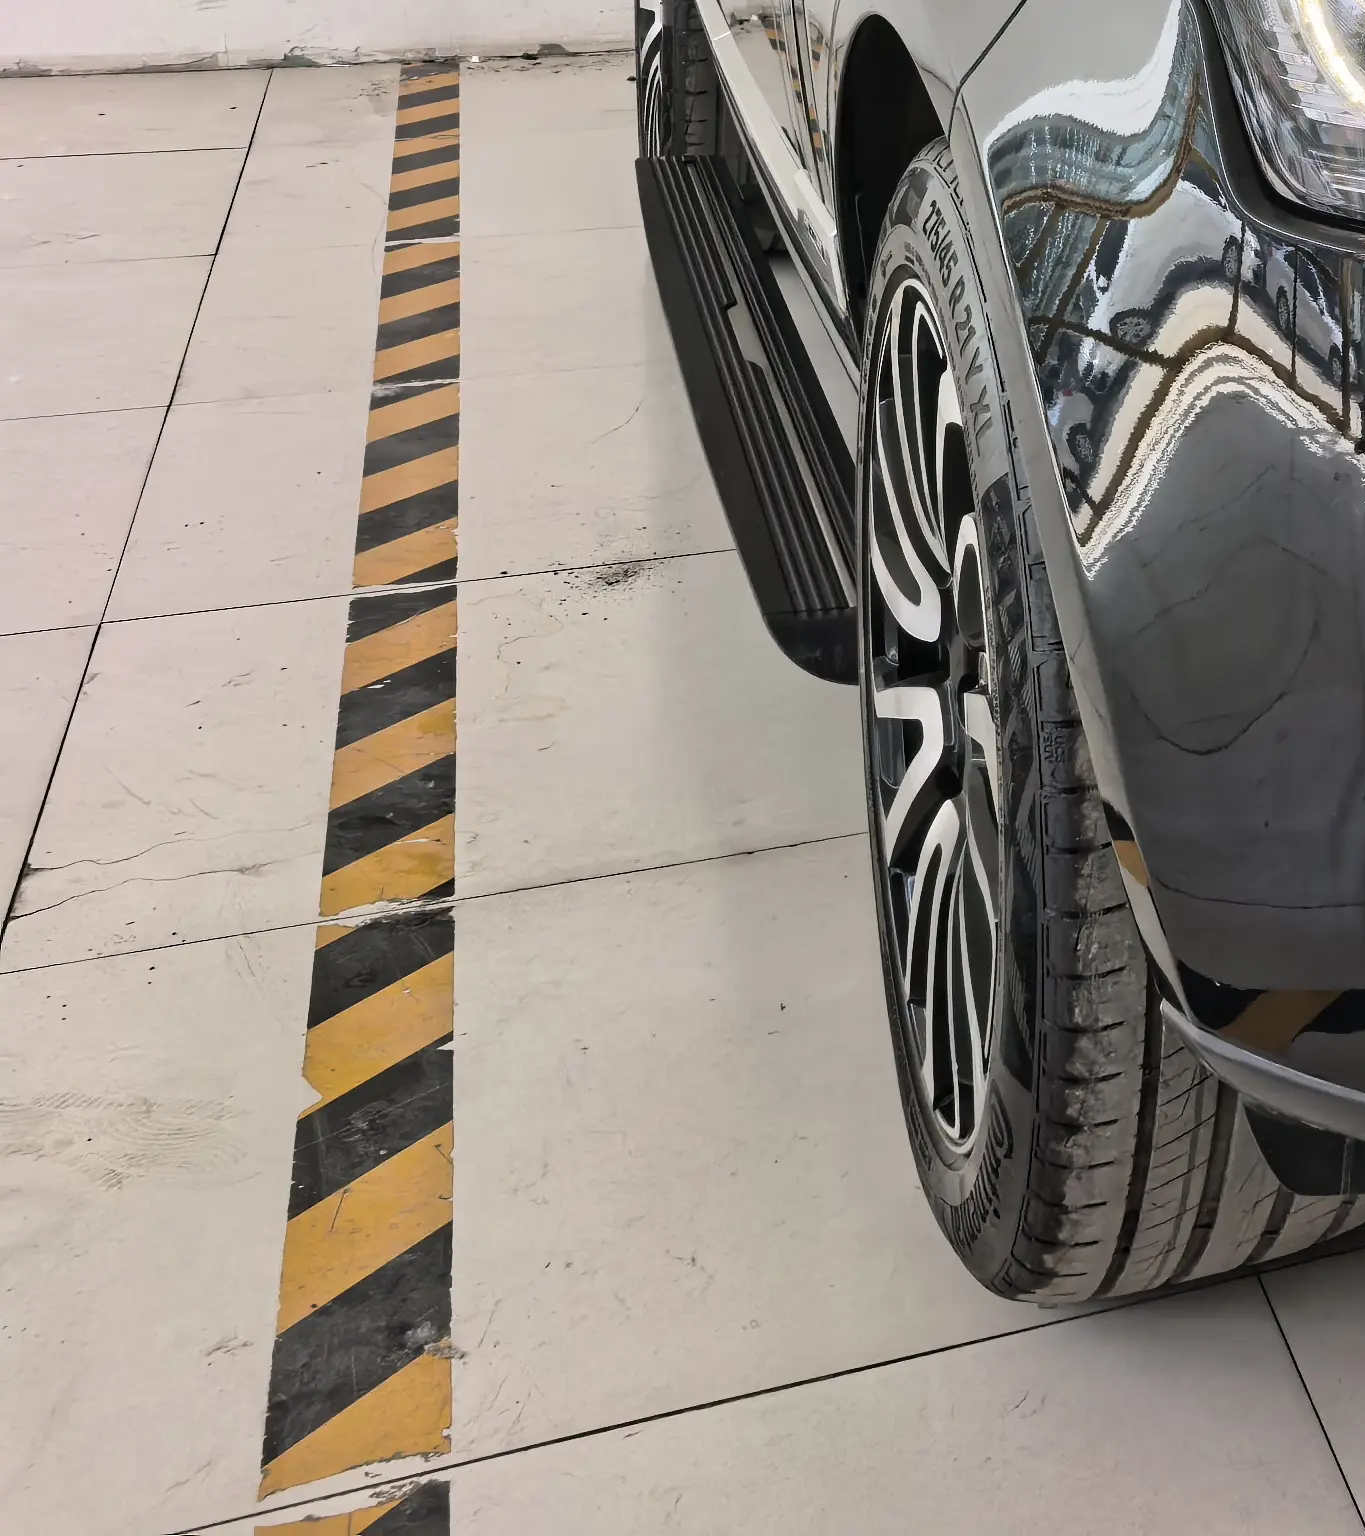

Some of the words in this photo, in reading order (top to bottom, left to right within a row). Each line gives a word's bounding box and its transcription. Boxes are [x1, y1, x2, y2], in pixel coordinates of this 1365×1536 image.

[921, 199, 959, 288] 275/45
[948, 275, 966, 320] R
[954, 304, 977, 359] 21
[970, 384, 993, 458] XL
